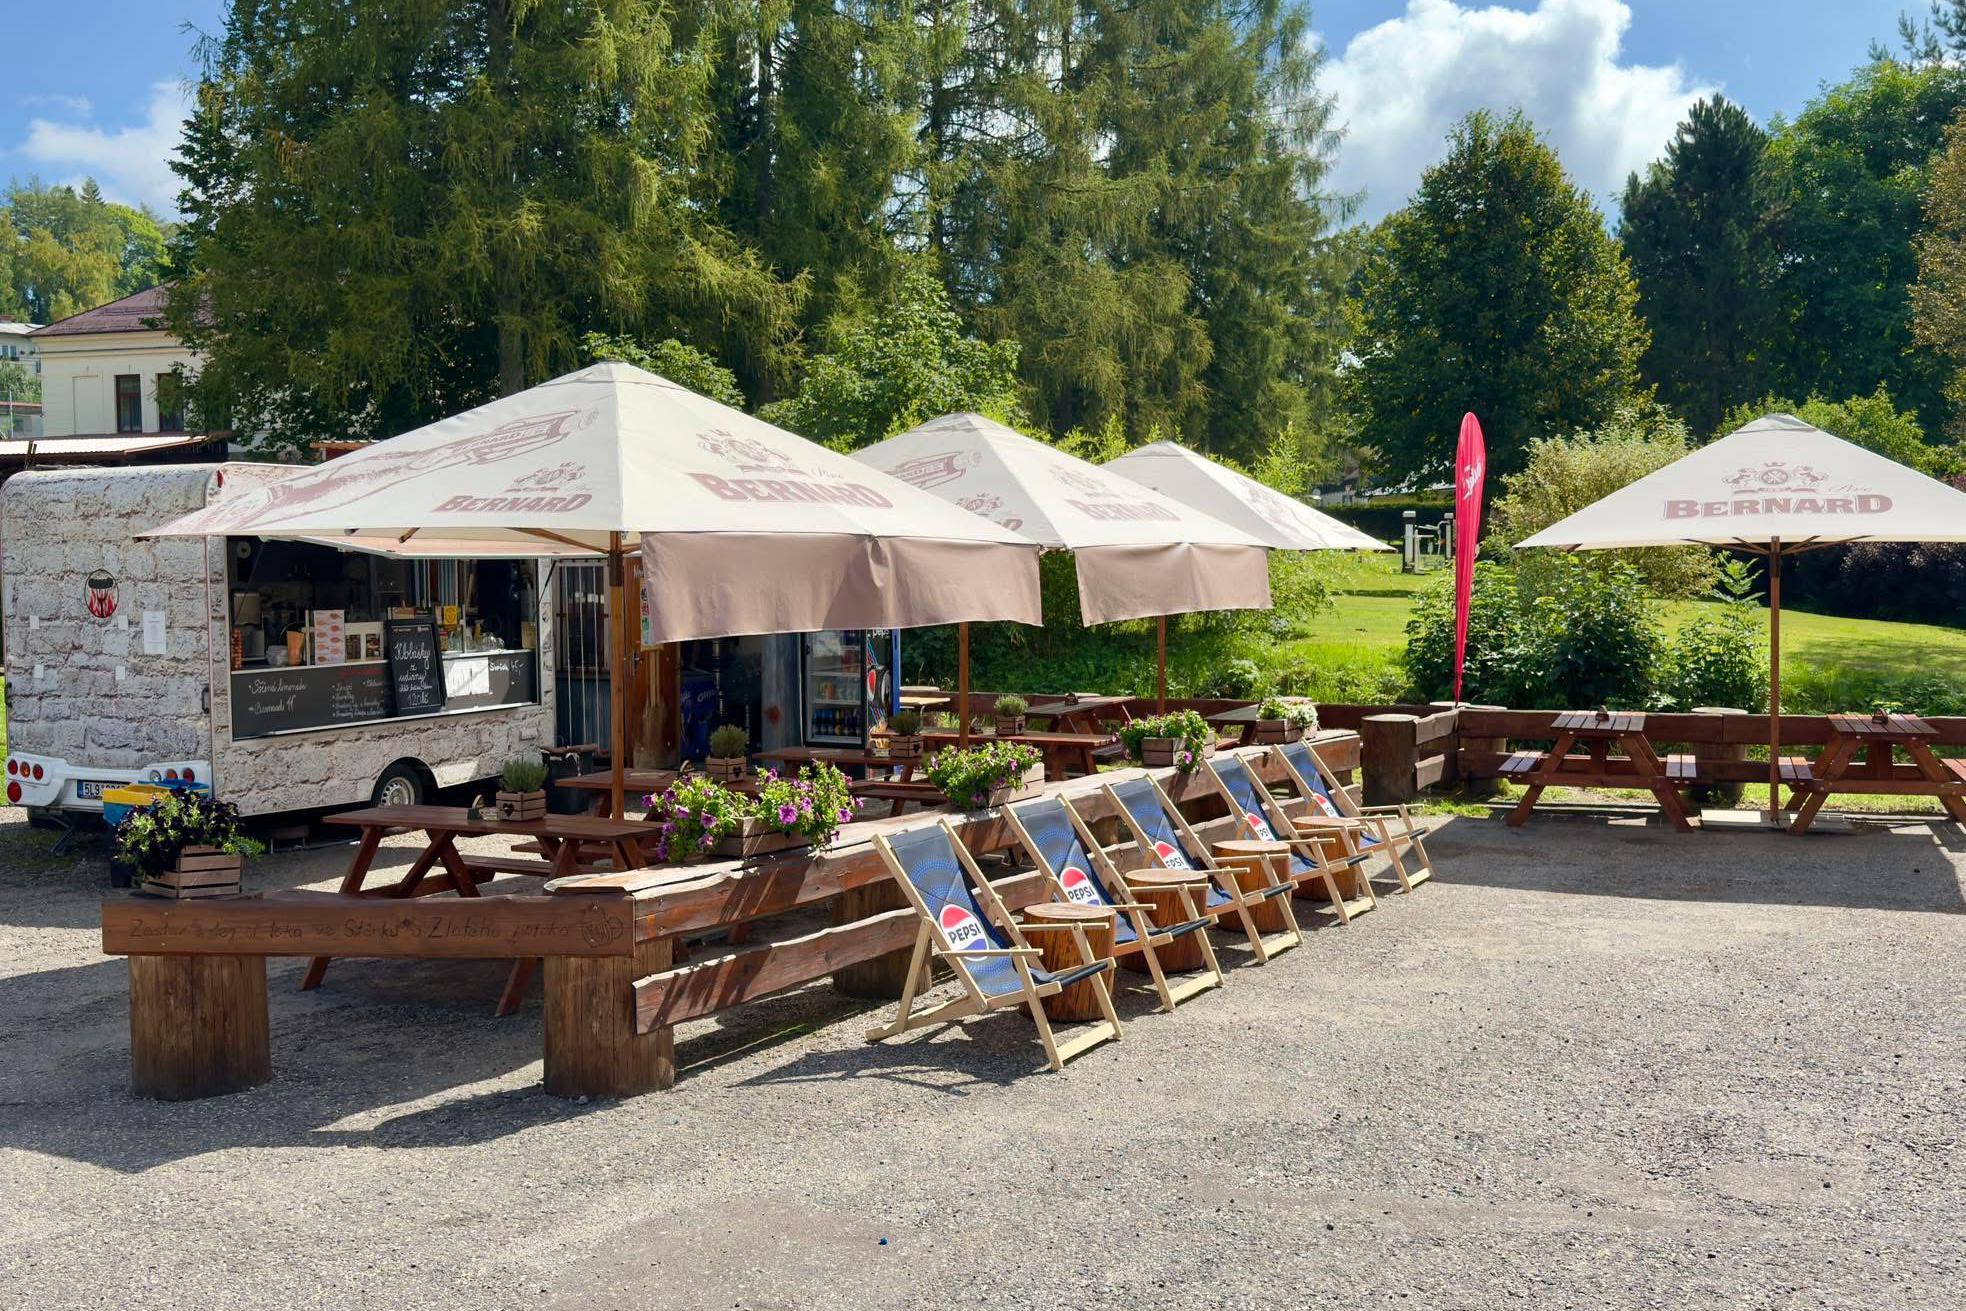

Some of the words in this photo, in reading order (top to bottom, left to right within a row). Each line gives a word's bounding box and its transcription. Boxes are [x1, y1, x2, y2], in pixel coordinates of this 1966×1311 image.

[685, 472, 894, 509] BERNARD
[432, 493, 593, 512] BERNARD
[1063, 499, 1182, 521] BERNARD
[1664, 494, 1894, 520] BERNARD
[1067, 885, 1095, 902] PEPSI
[947, 922, 982, 945] PEPSI
